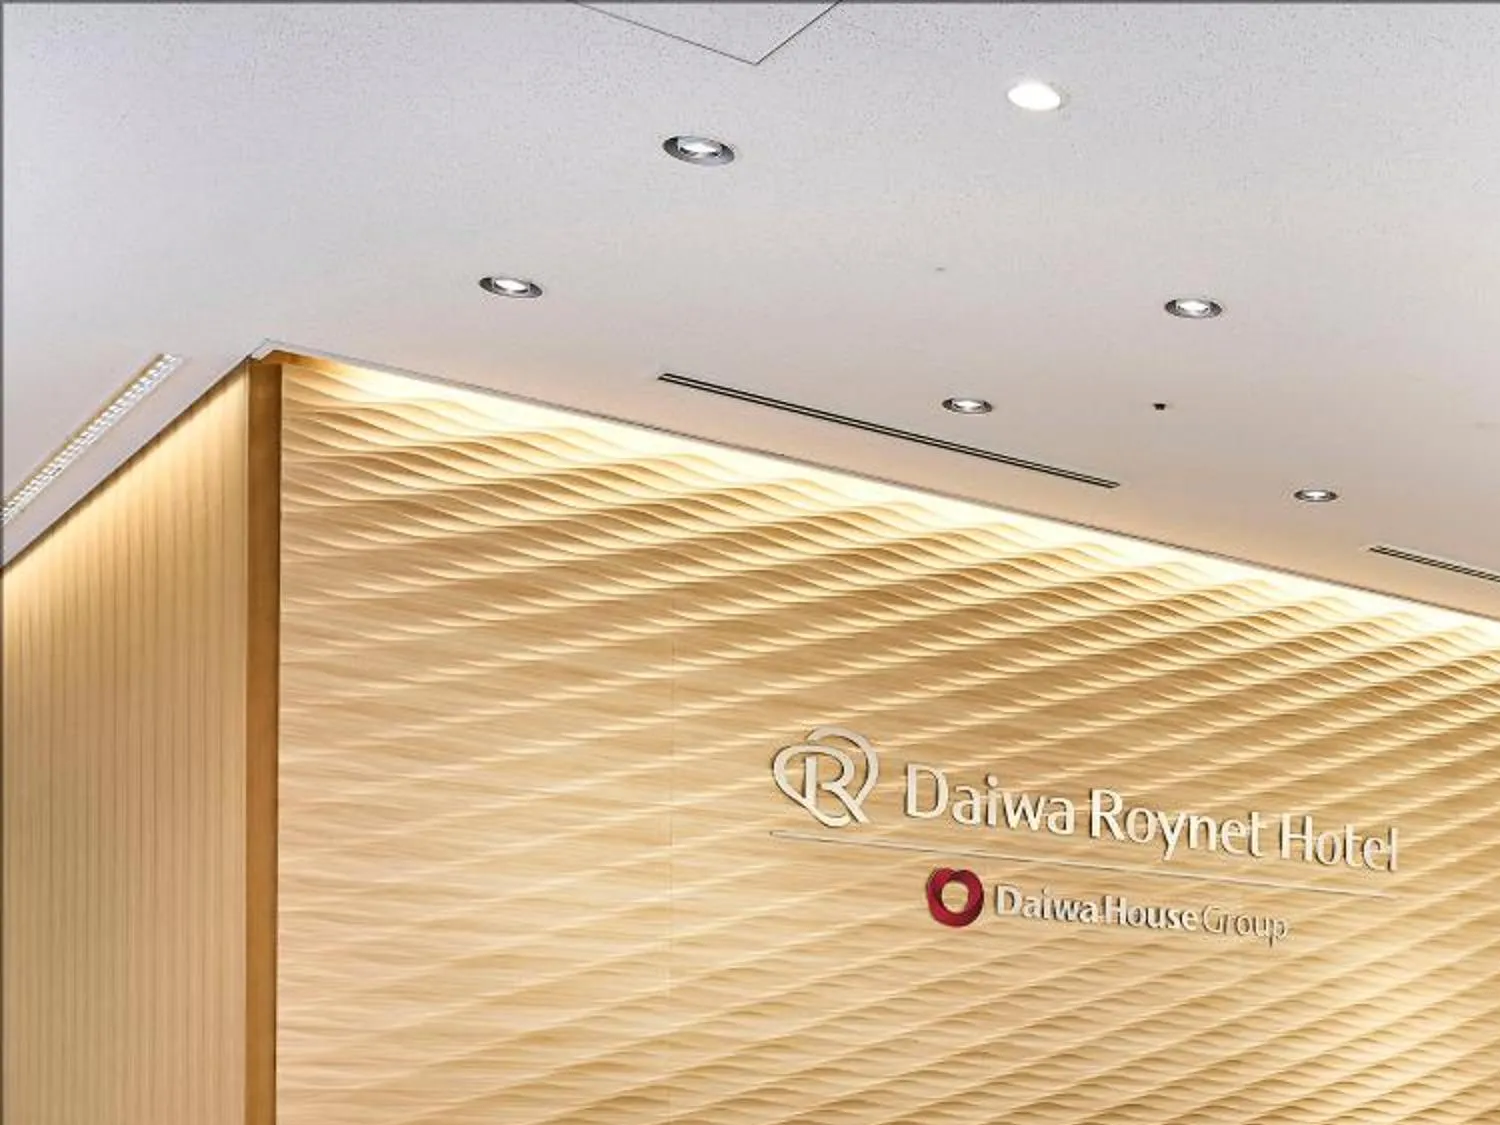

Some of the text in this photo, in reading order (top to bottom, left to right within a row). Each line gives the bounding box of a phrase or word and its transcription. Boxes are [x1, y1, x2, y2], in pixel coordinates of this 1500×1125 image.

[904, 763, 1400, 871] Daiwa Roynet Hotel
[1201, 904, 1290, 947] Group
